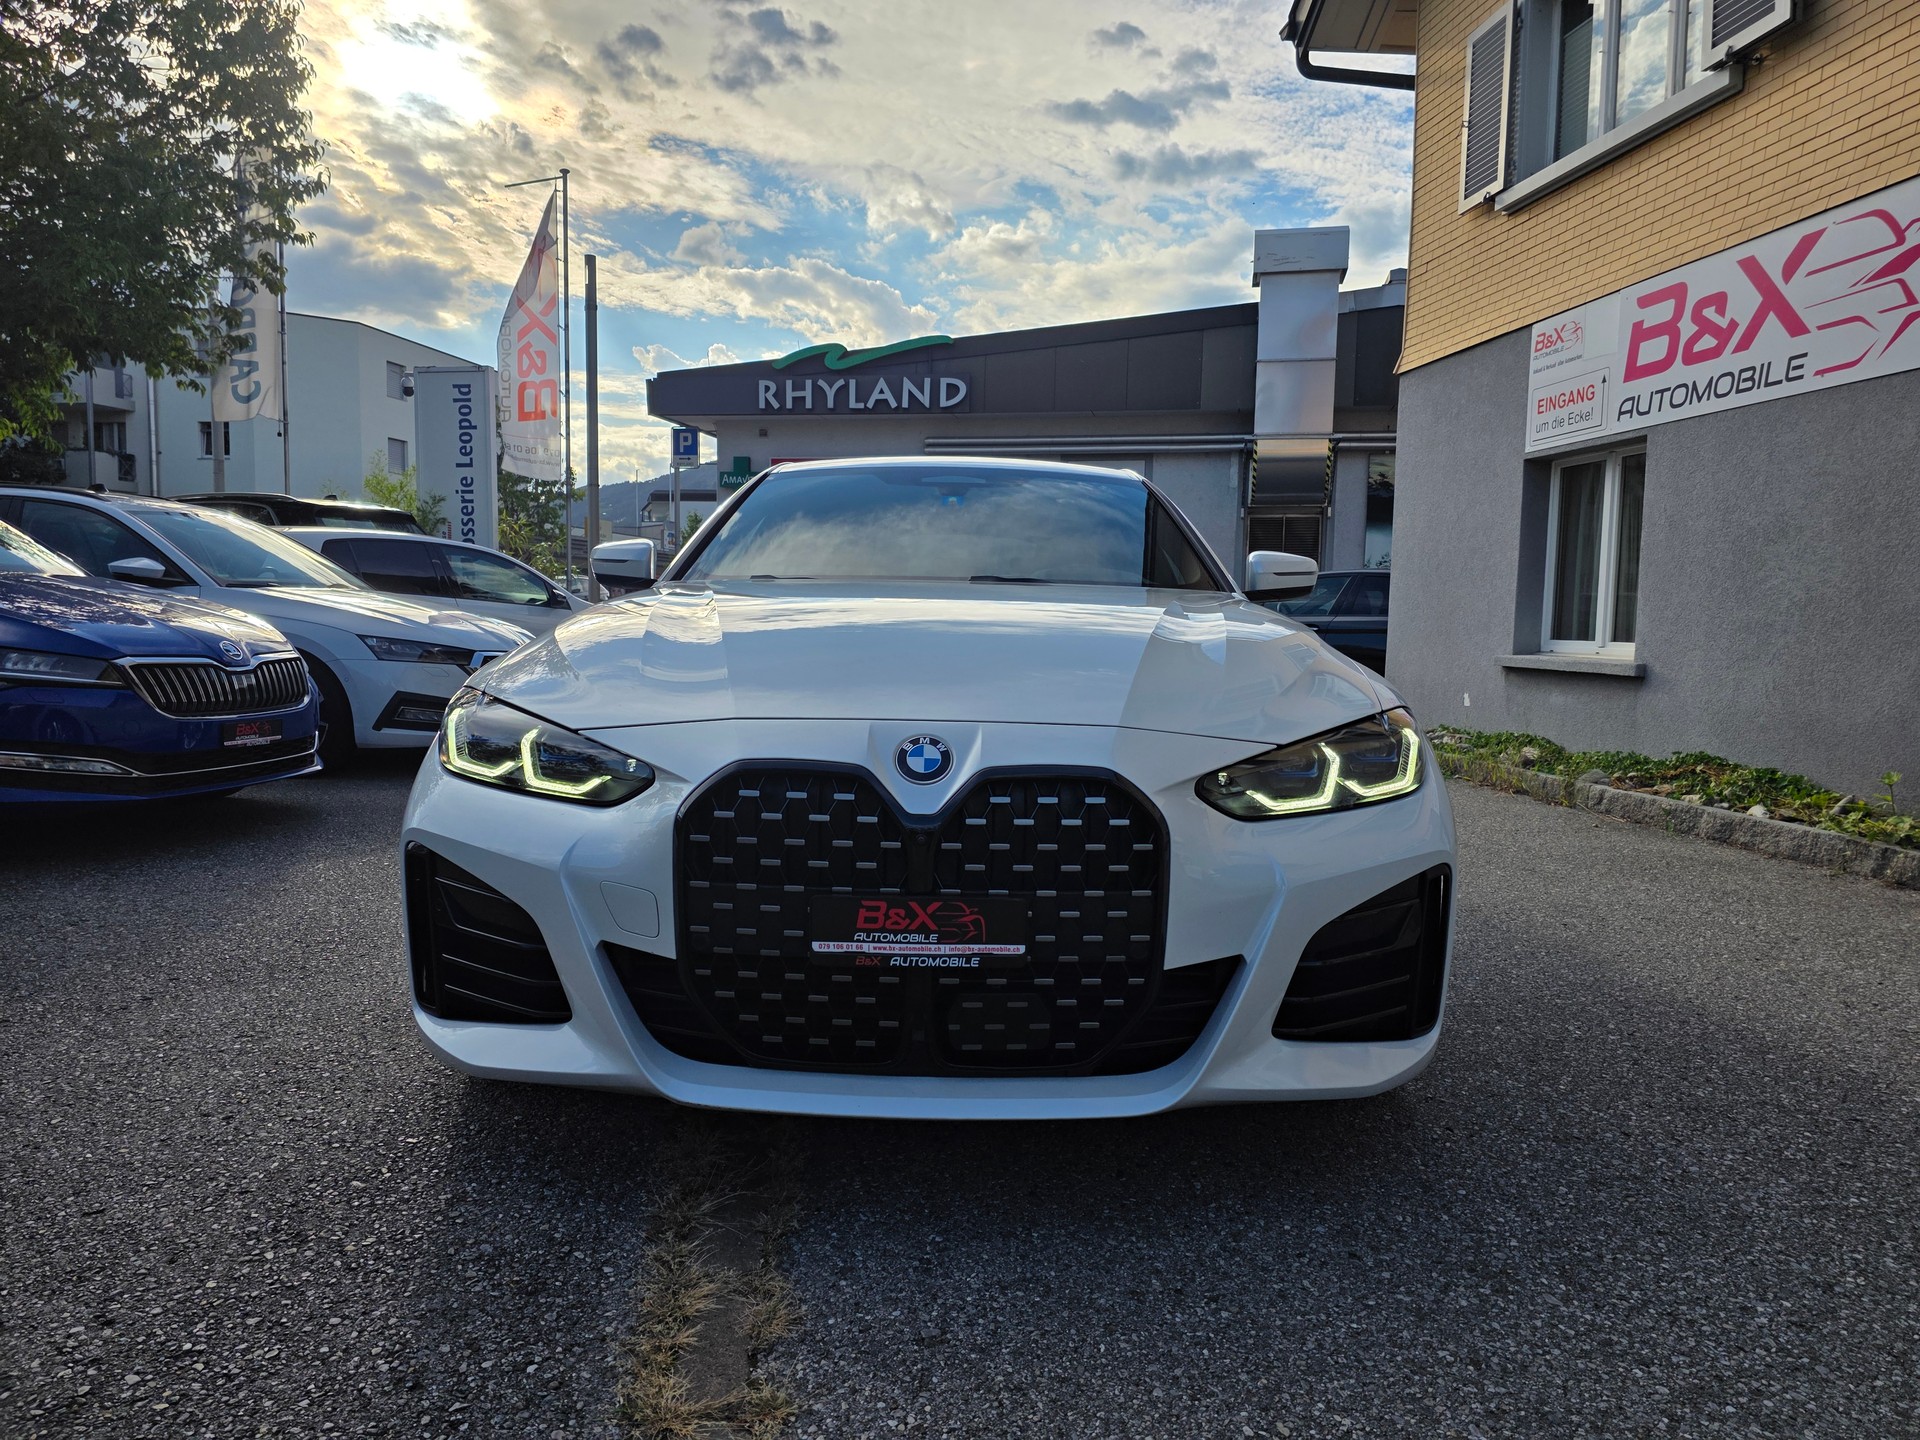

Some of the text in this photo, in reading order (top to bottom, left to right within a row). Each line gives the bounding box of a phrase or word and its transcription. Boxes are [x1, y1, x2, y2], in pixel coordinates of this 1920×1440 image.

[1623, 227, 1828, 383] B&X
[758, 376, 967, 410] RHYLAND
[1537, 384, 1595, 415] EINGANG
[1617, 352, 1809, 422] AUTOMOBILE
[452, 383, 477, 468] Leopold
[1536, 406, 1594, 434] um die Ecke!
[680, 432, 692, 453] P
[903, 737, 947, 752] BMW
[856, 900, 943, 931] B&X
[854, 932, 939, 943] AUTOMOBILE
[890, 956, 981, 967] AUTOMOBILE
